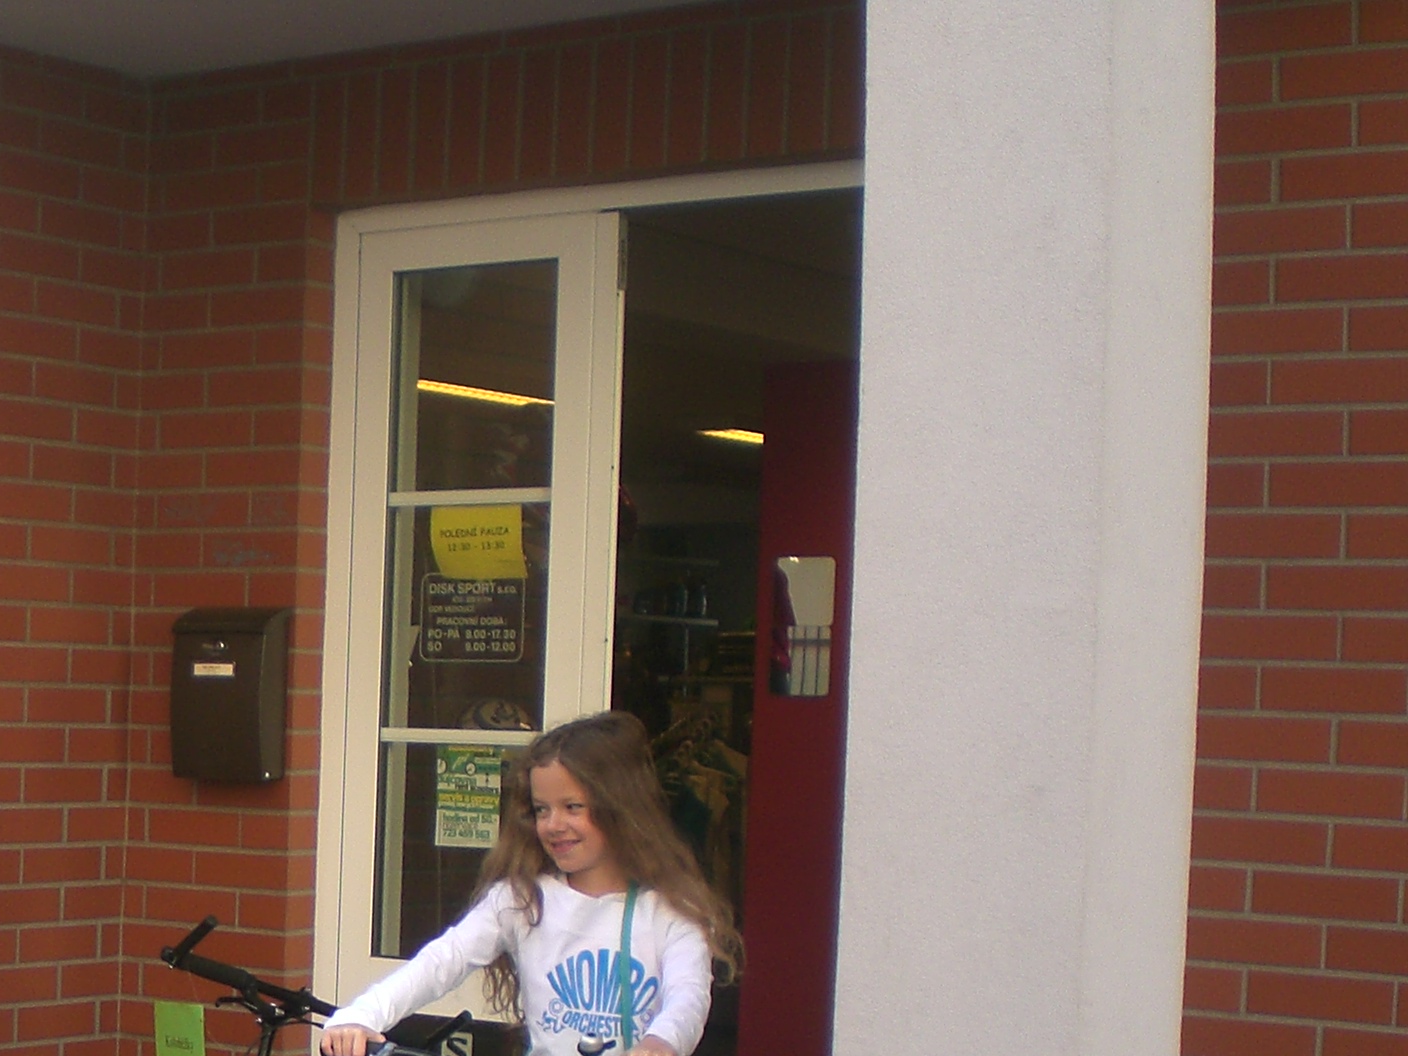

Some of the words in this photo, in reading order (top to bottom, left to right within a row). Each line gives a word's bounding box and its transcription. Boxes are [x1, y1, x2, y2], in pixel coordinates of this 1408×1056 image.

[429, 583, 455, 594] DISK
[457, 582, 496, 594] SPORT
[427, 641, 442, 651] SO
